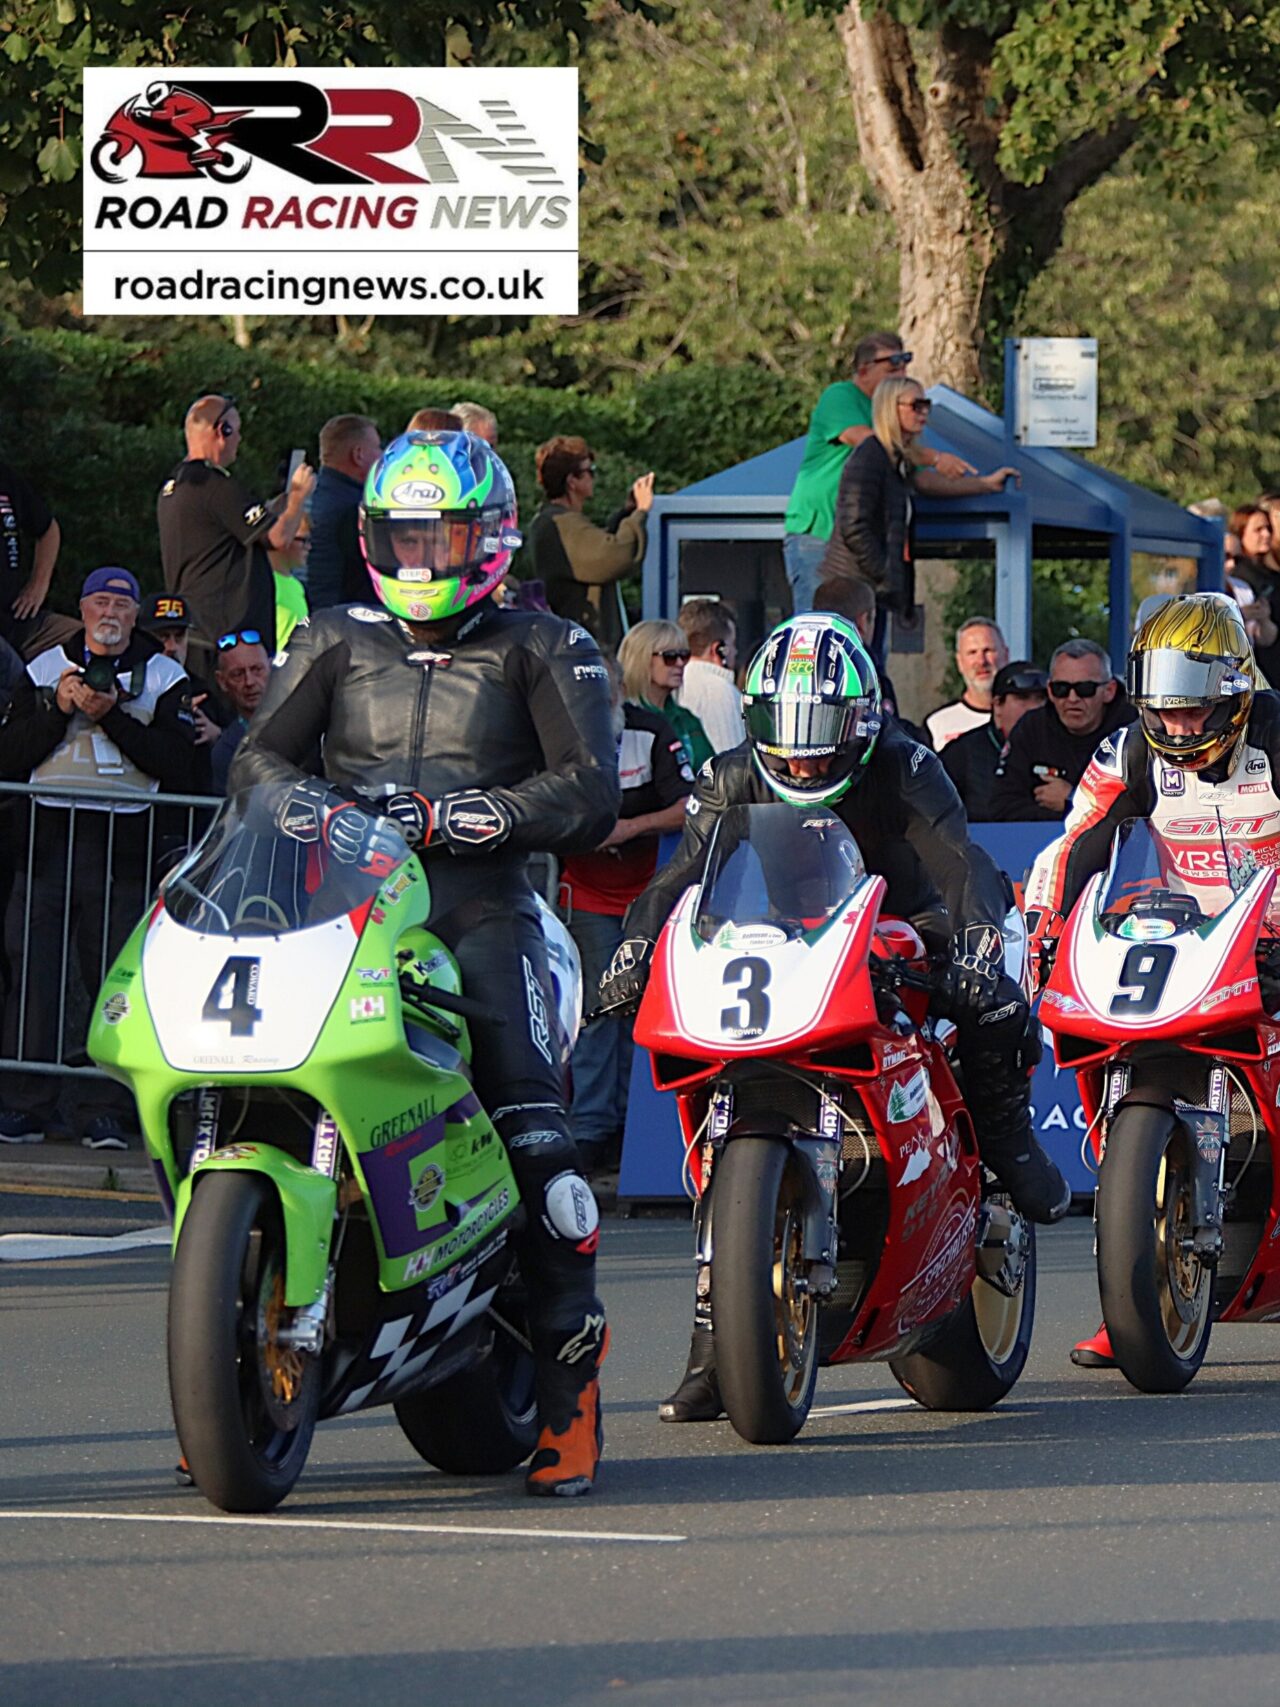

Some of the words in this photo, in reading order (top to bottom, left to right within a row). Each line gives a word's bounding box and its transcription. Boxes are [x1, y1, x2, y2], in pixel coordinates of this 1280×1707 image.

[398, 481, 438, 500] Arai
[910, 746, 929, 776] RS
[1240, 783, 1269, 794] MOTUL
[1163, 810, 1280, 836] SMT
[202, 955, 264, 1038] 4
[246, 963, 261, 1006] COWARD
[720, 956, 772, 1041] 3
[1108, 943, 1179, 1017] 9
[522, 954, 553, 1066] RST
[978, 1000, 1024, 1026] RST
[370, 1094, 439, 1150] GREENALL
[509, 1130, 563, 1150] RST
[431, 1186, 510, 1265] MOTORCYCLES
